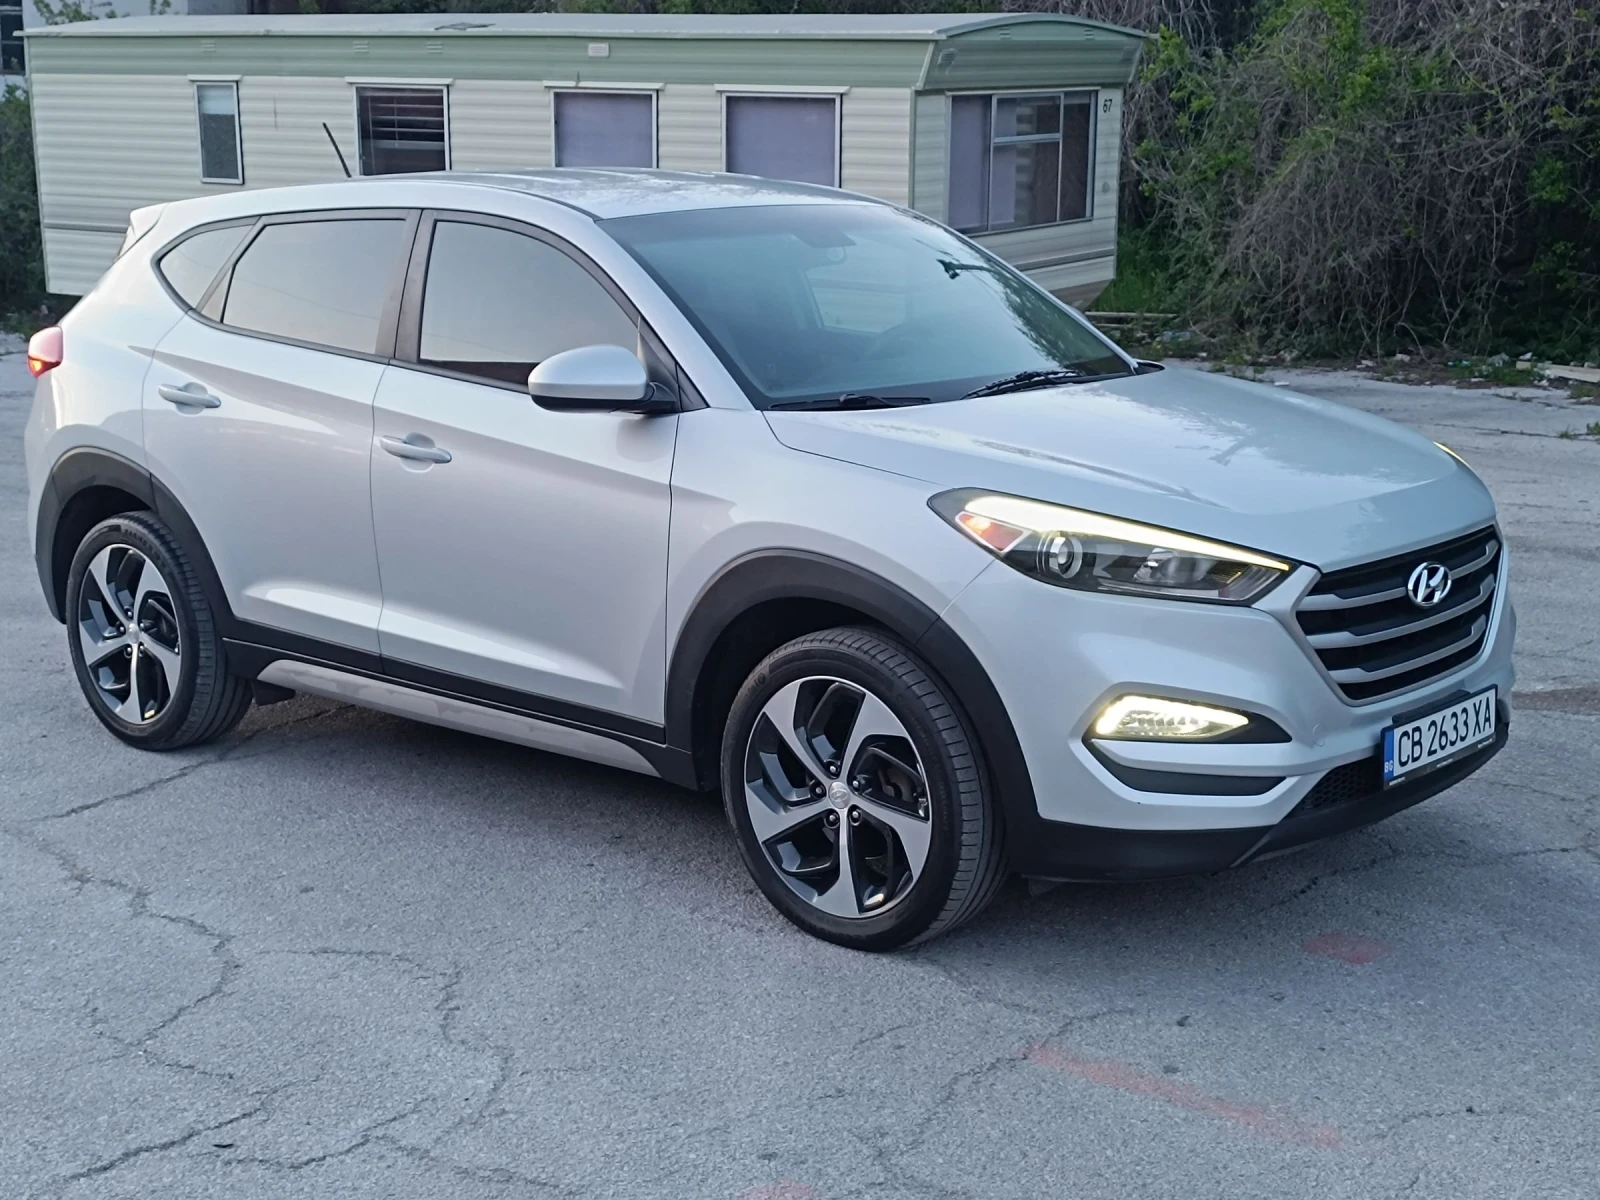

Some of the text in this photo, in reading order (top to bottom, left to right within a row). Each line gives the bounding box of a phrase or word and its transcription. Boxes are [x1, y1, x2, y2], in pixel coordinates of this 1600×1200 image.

[1102, 98, 1113, 113] 67
[1398, 697, 1492, 767] CB 2633 XA
[1384, 760, 1394, 773] BG
